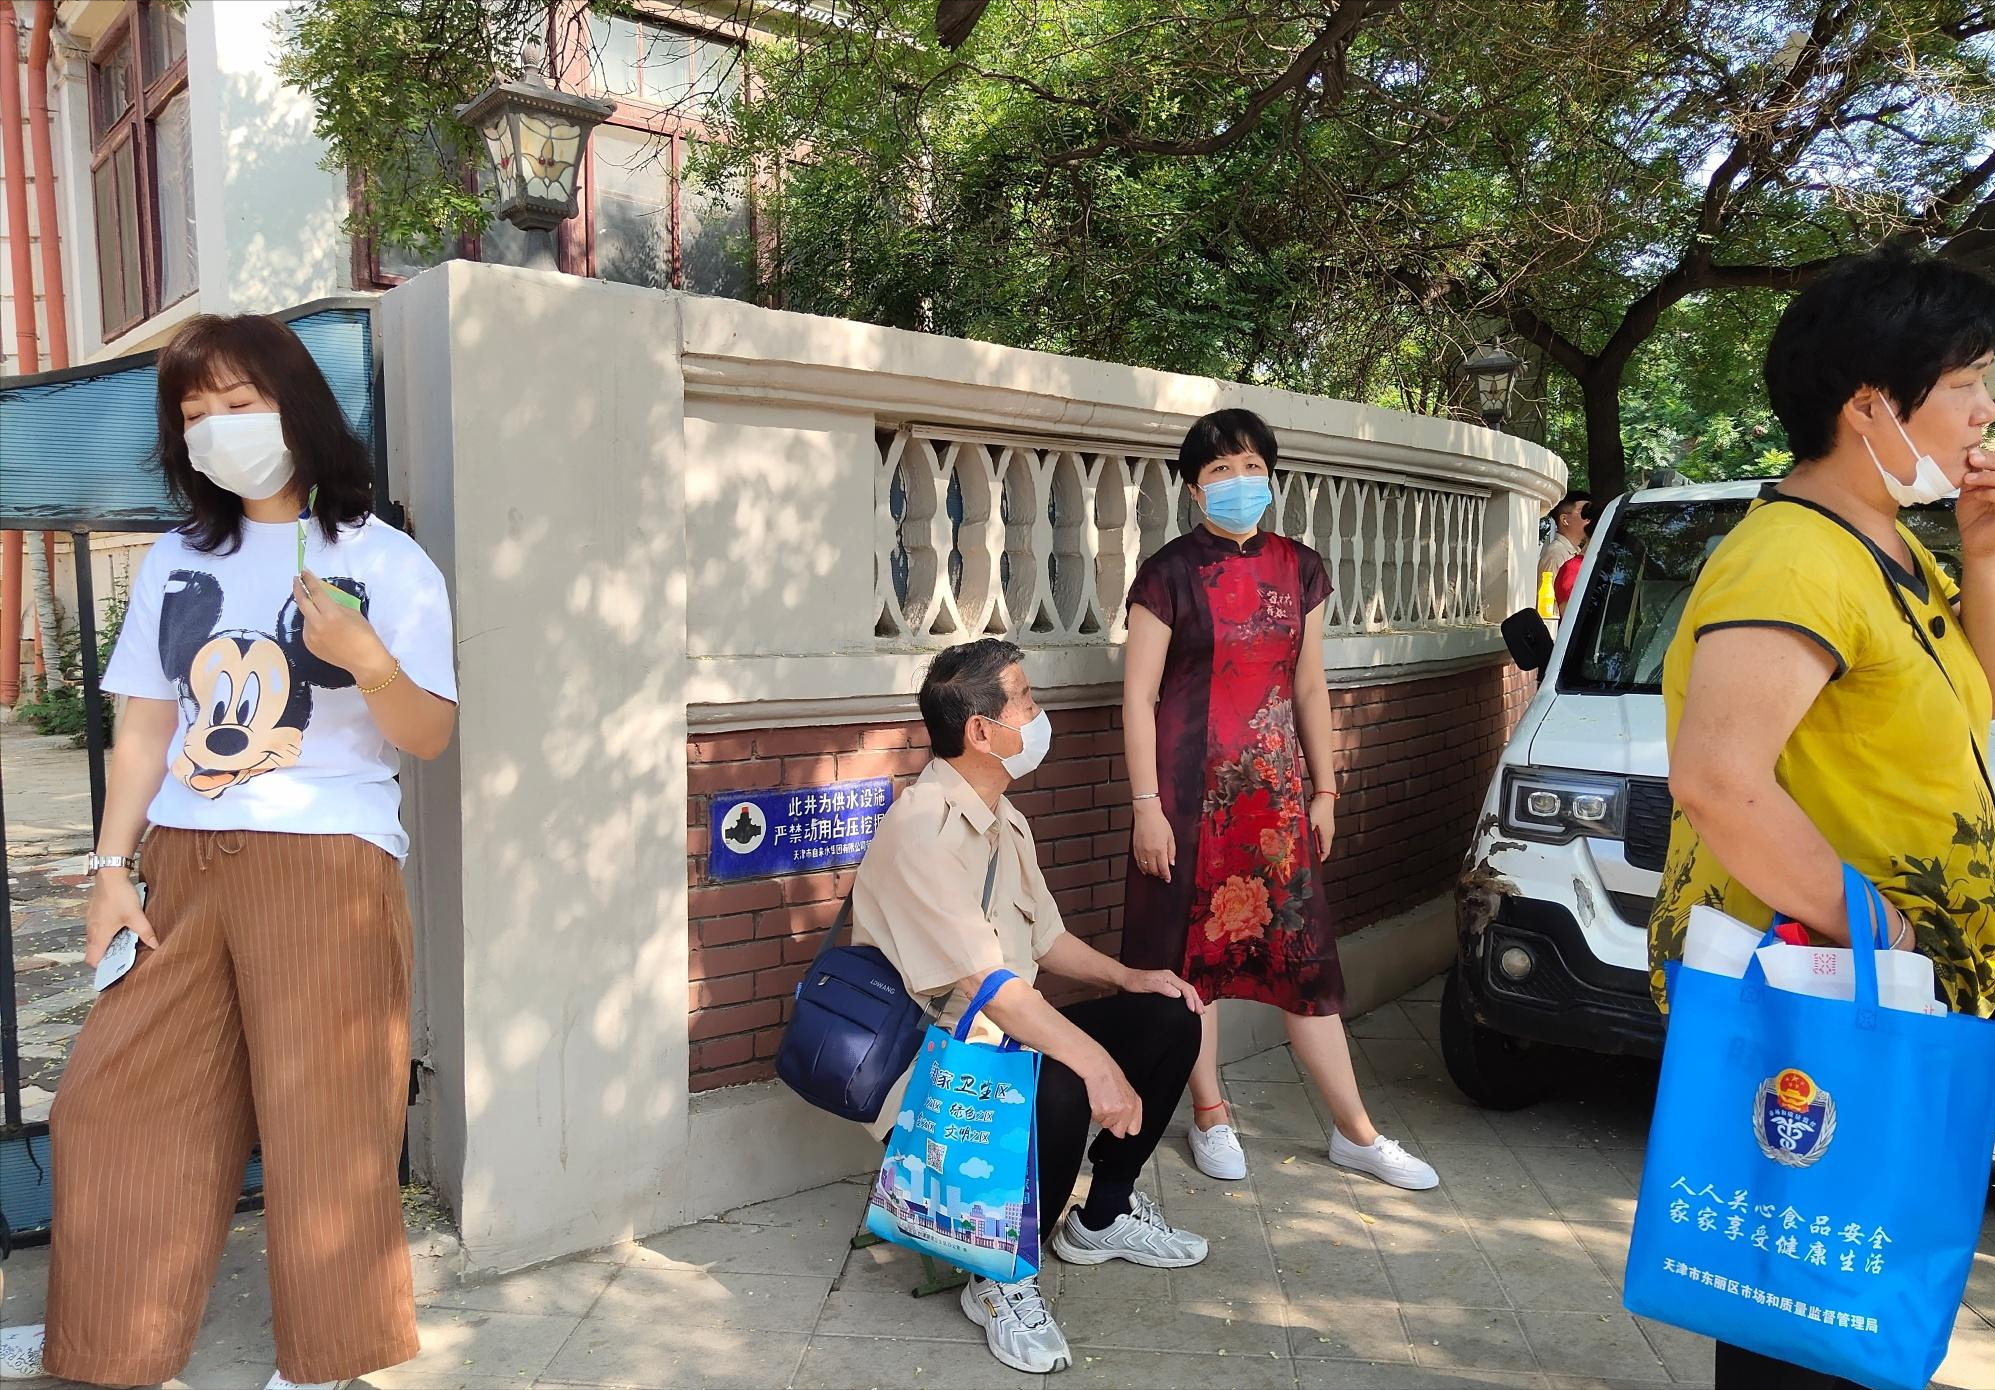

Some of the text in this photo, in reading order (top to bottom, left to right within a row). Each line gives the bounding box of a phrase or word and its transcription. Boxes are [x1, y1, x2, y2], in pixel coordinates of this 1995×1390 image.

[788, 788, 886, 817] 此井为供水设施
[944, 1123, 992, 1145] 文明之区
[1669, 1175, 1893, 1251] 人人关心食品安全
[1669, 1198, 1885, 1275] 家家享受健康生活
[1663, 1257, 1879, 1334] 天津市东丽区市场和质量监督管理局
